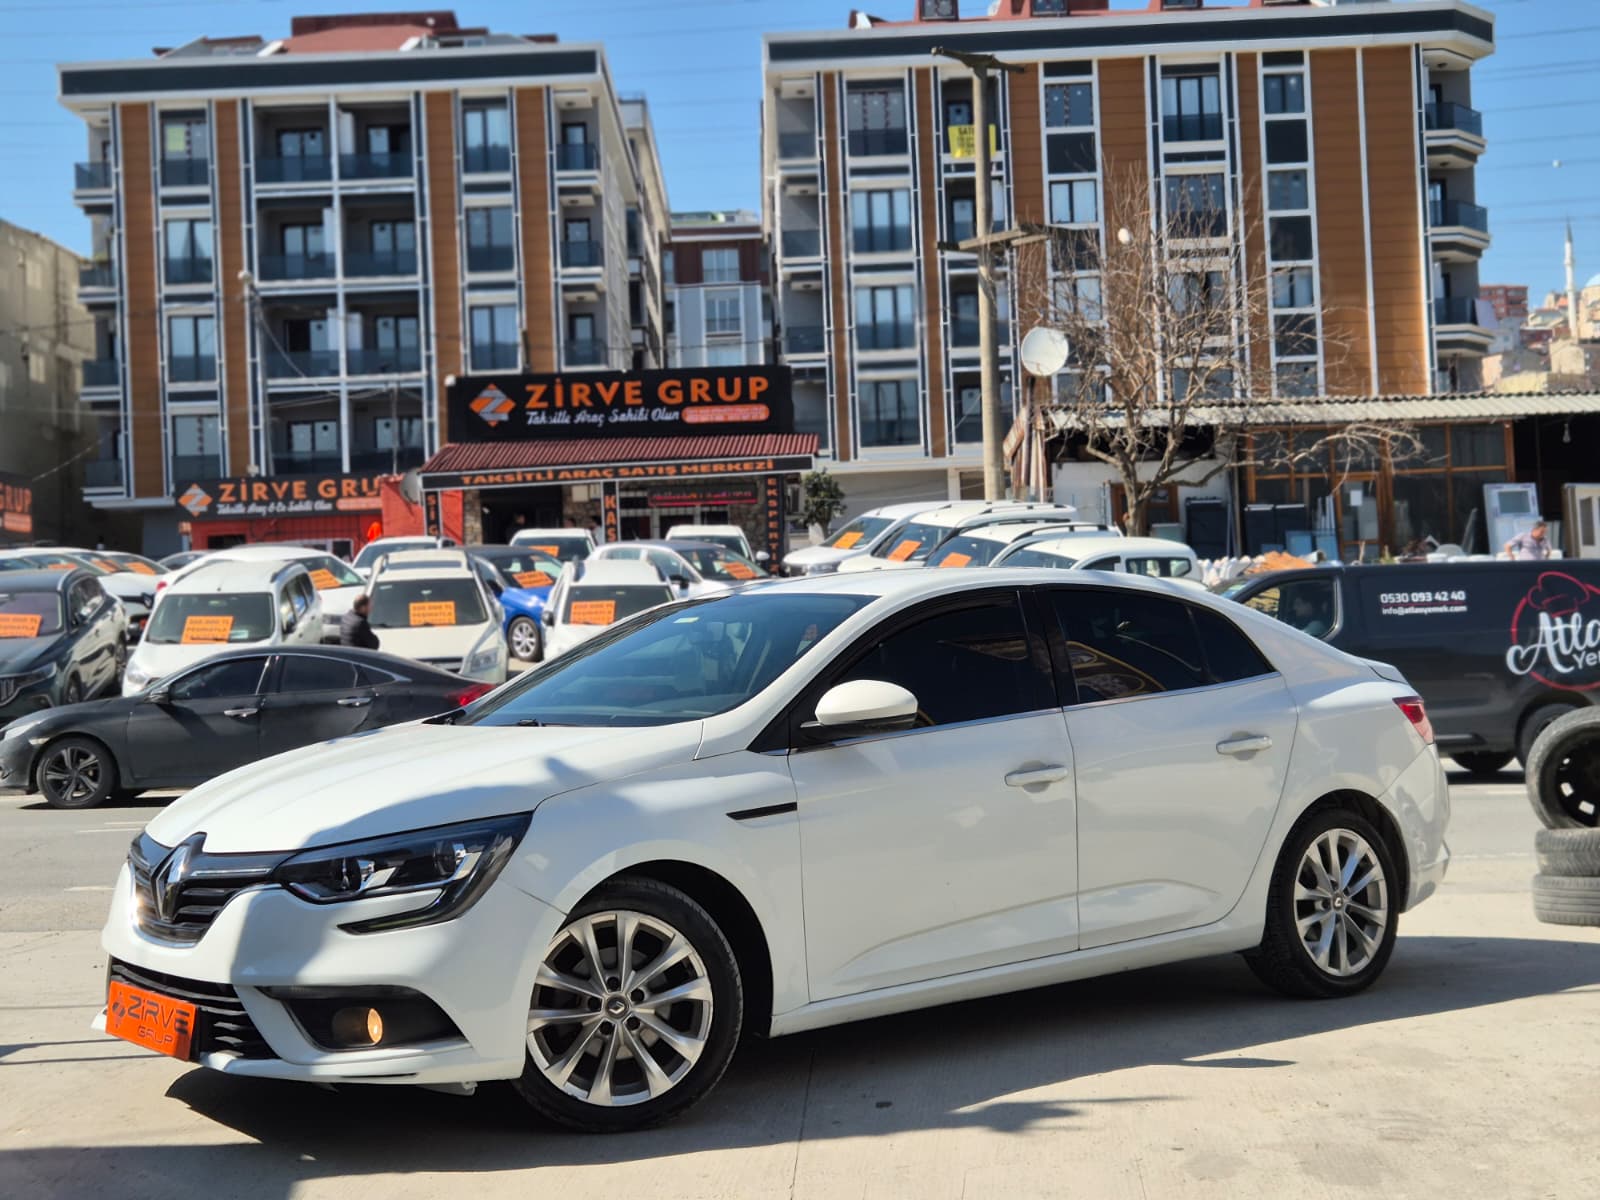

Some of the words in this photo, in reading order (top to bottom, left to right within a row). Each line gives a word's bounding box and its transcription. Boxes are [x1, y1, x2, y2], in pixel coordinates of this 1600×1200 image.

[525, 378, 643, 409] ZİRVE
[657, 376, 769, 405] GRUP
[573, 409, 605, 427] Araç
[608, 406, 650, 423] Sahibi
[651, 406, 680, 422] Olun
[461, 469, 554, 485] TAKSİTLİ
[558, 467, 613, 479] ARAÇ
[617, 465, 677, 477] SATIŞ
[680, 458, 774, 474] MERKEZİ
[0, 482, 32, 512] RUP
[218, 478, 306, 502] ZİRVE
[317, 478, 379, 497] GRU
[604, 495, 616, 541] KAS
[1380, 592, 1409, 604] 0530
[1411, 591, 1433, 602] 093
[1434, 591, 1449, 602] 42
[1451, 590, 1466, 601] 40
[1572, 651, 1600, 670] Ye
[137, 1025, 174, 1045] GRUP
